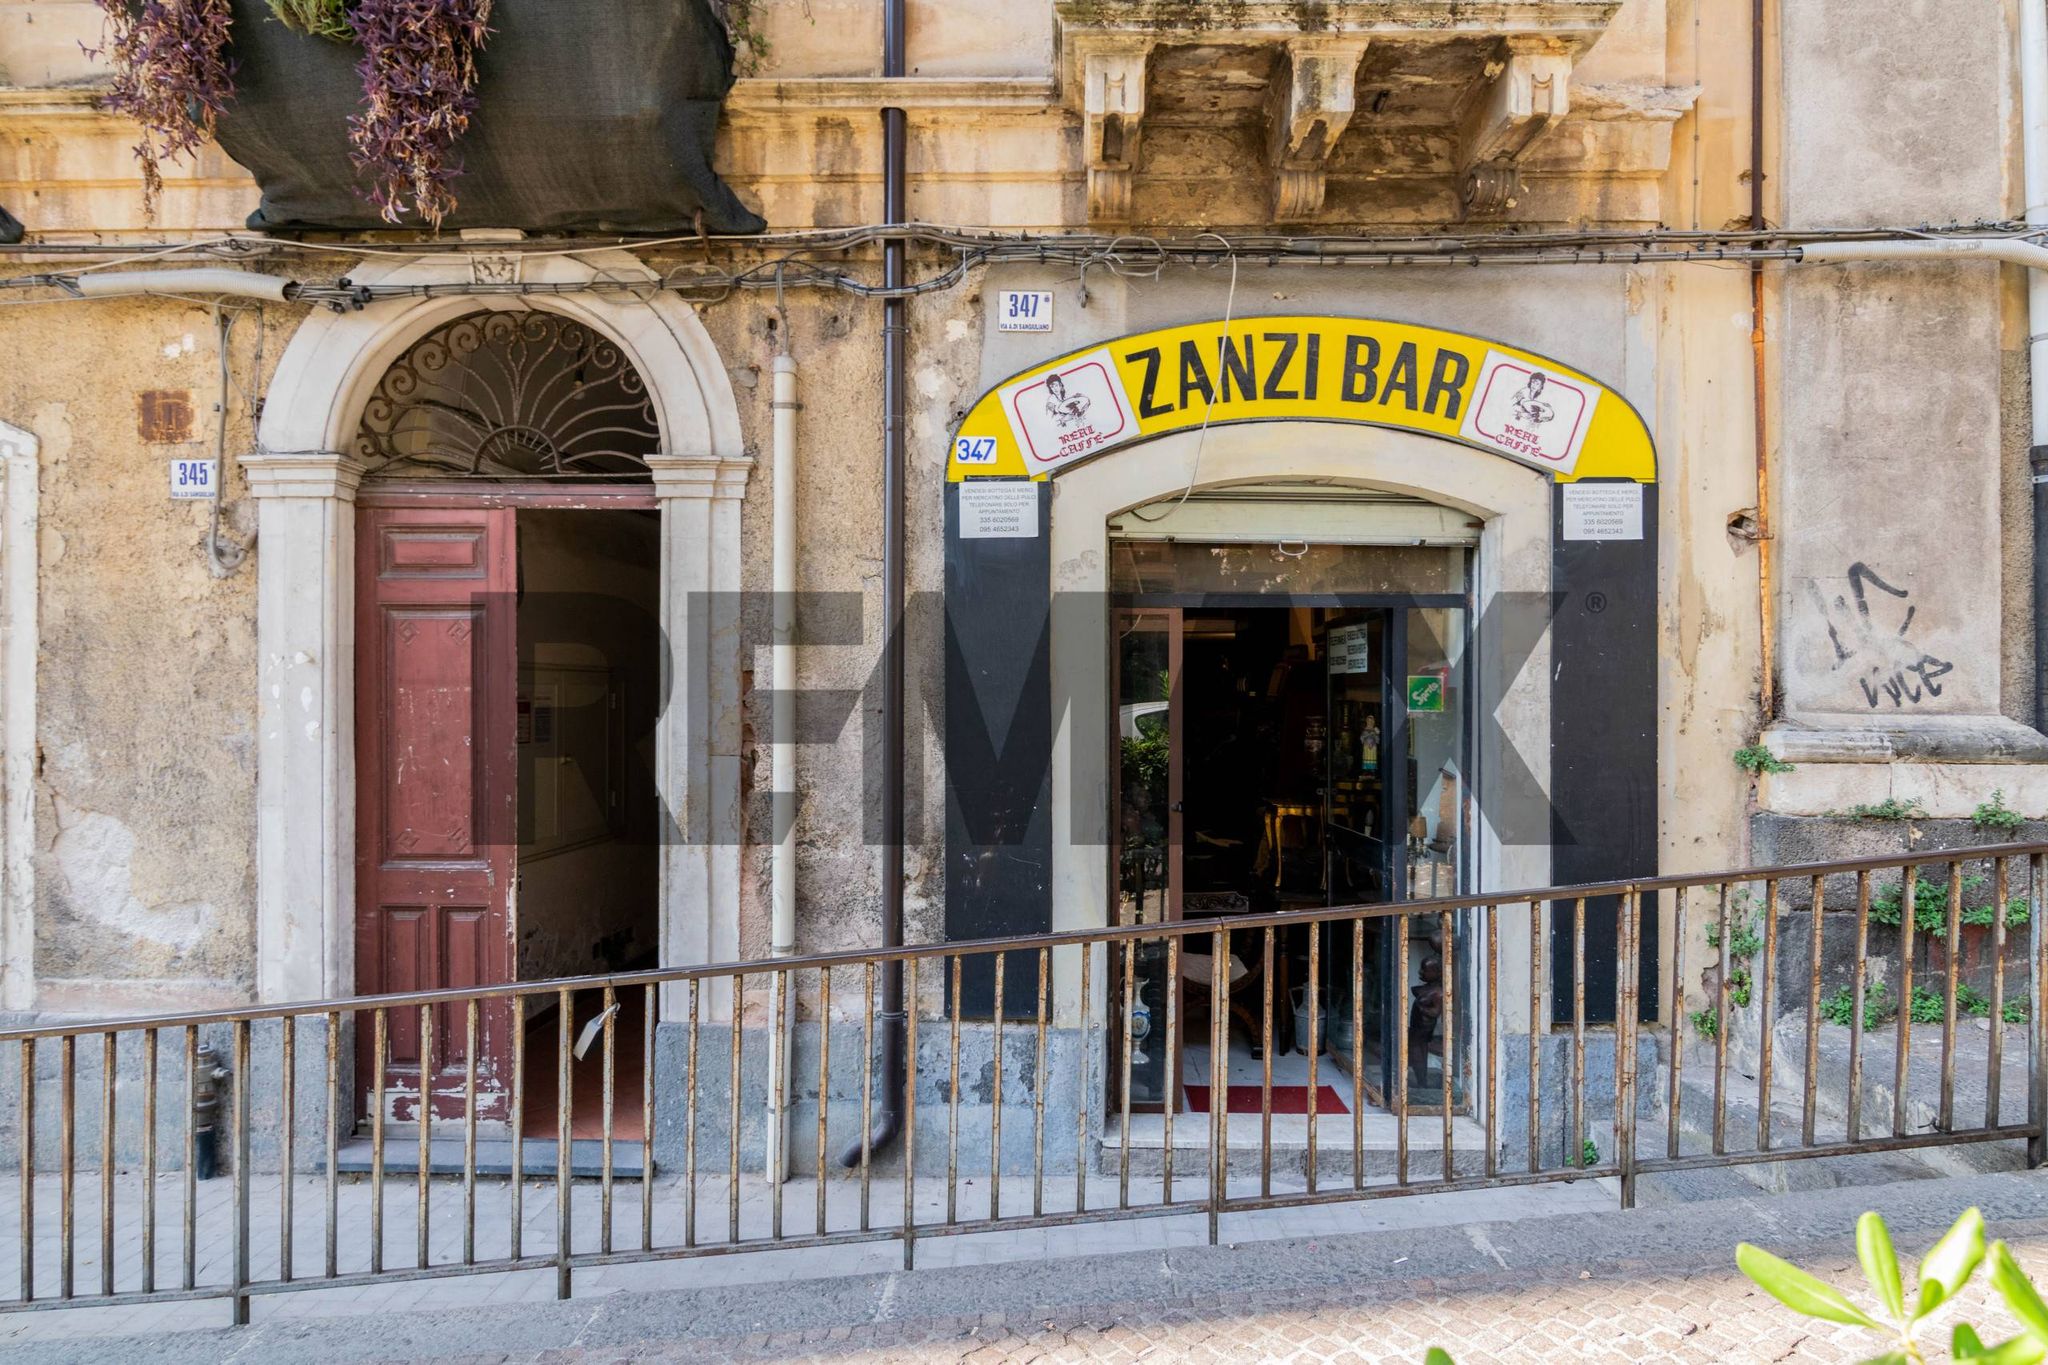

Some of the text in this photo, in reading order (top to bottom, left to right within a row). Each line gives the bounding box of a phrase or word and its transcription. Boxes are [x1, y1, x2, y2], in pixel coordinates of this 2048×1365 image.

[1009, 294, 1039, 317] 347
[1125, 332, 1470, 421] ZANZI BAR
[1058, 424, 1096, 445] REAL
[1504, 423, 1540, 445] REAL
[957, 439, 996, 461] 347
[179, 462, 208, 486] 345
